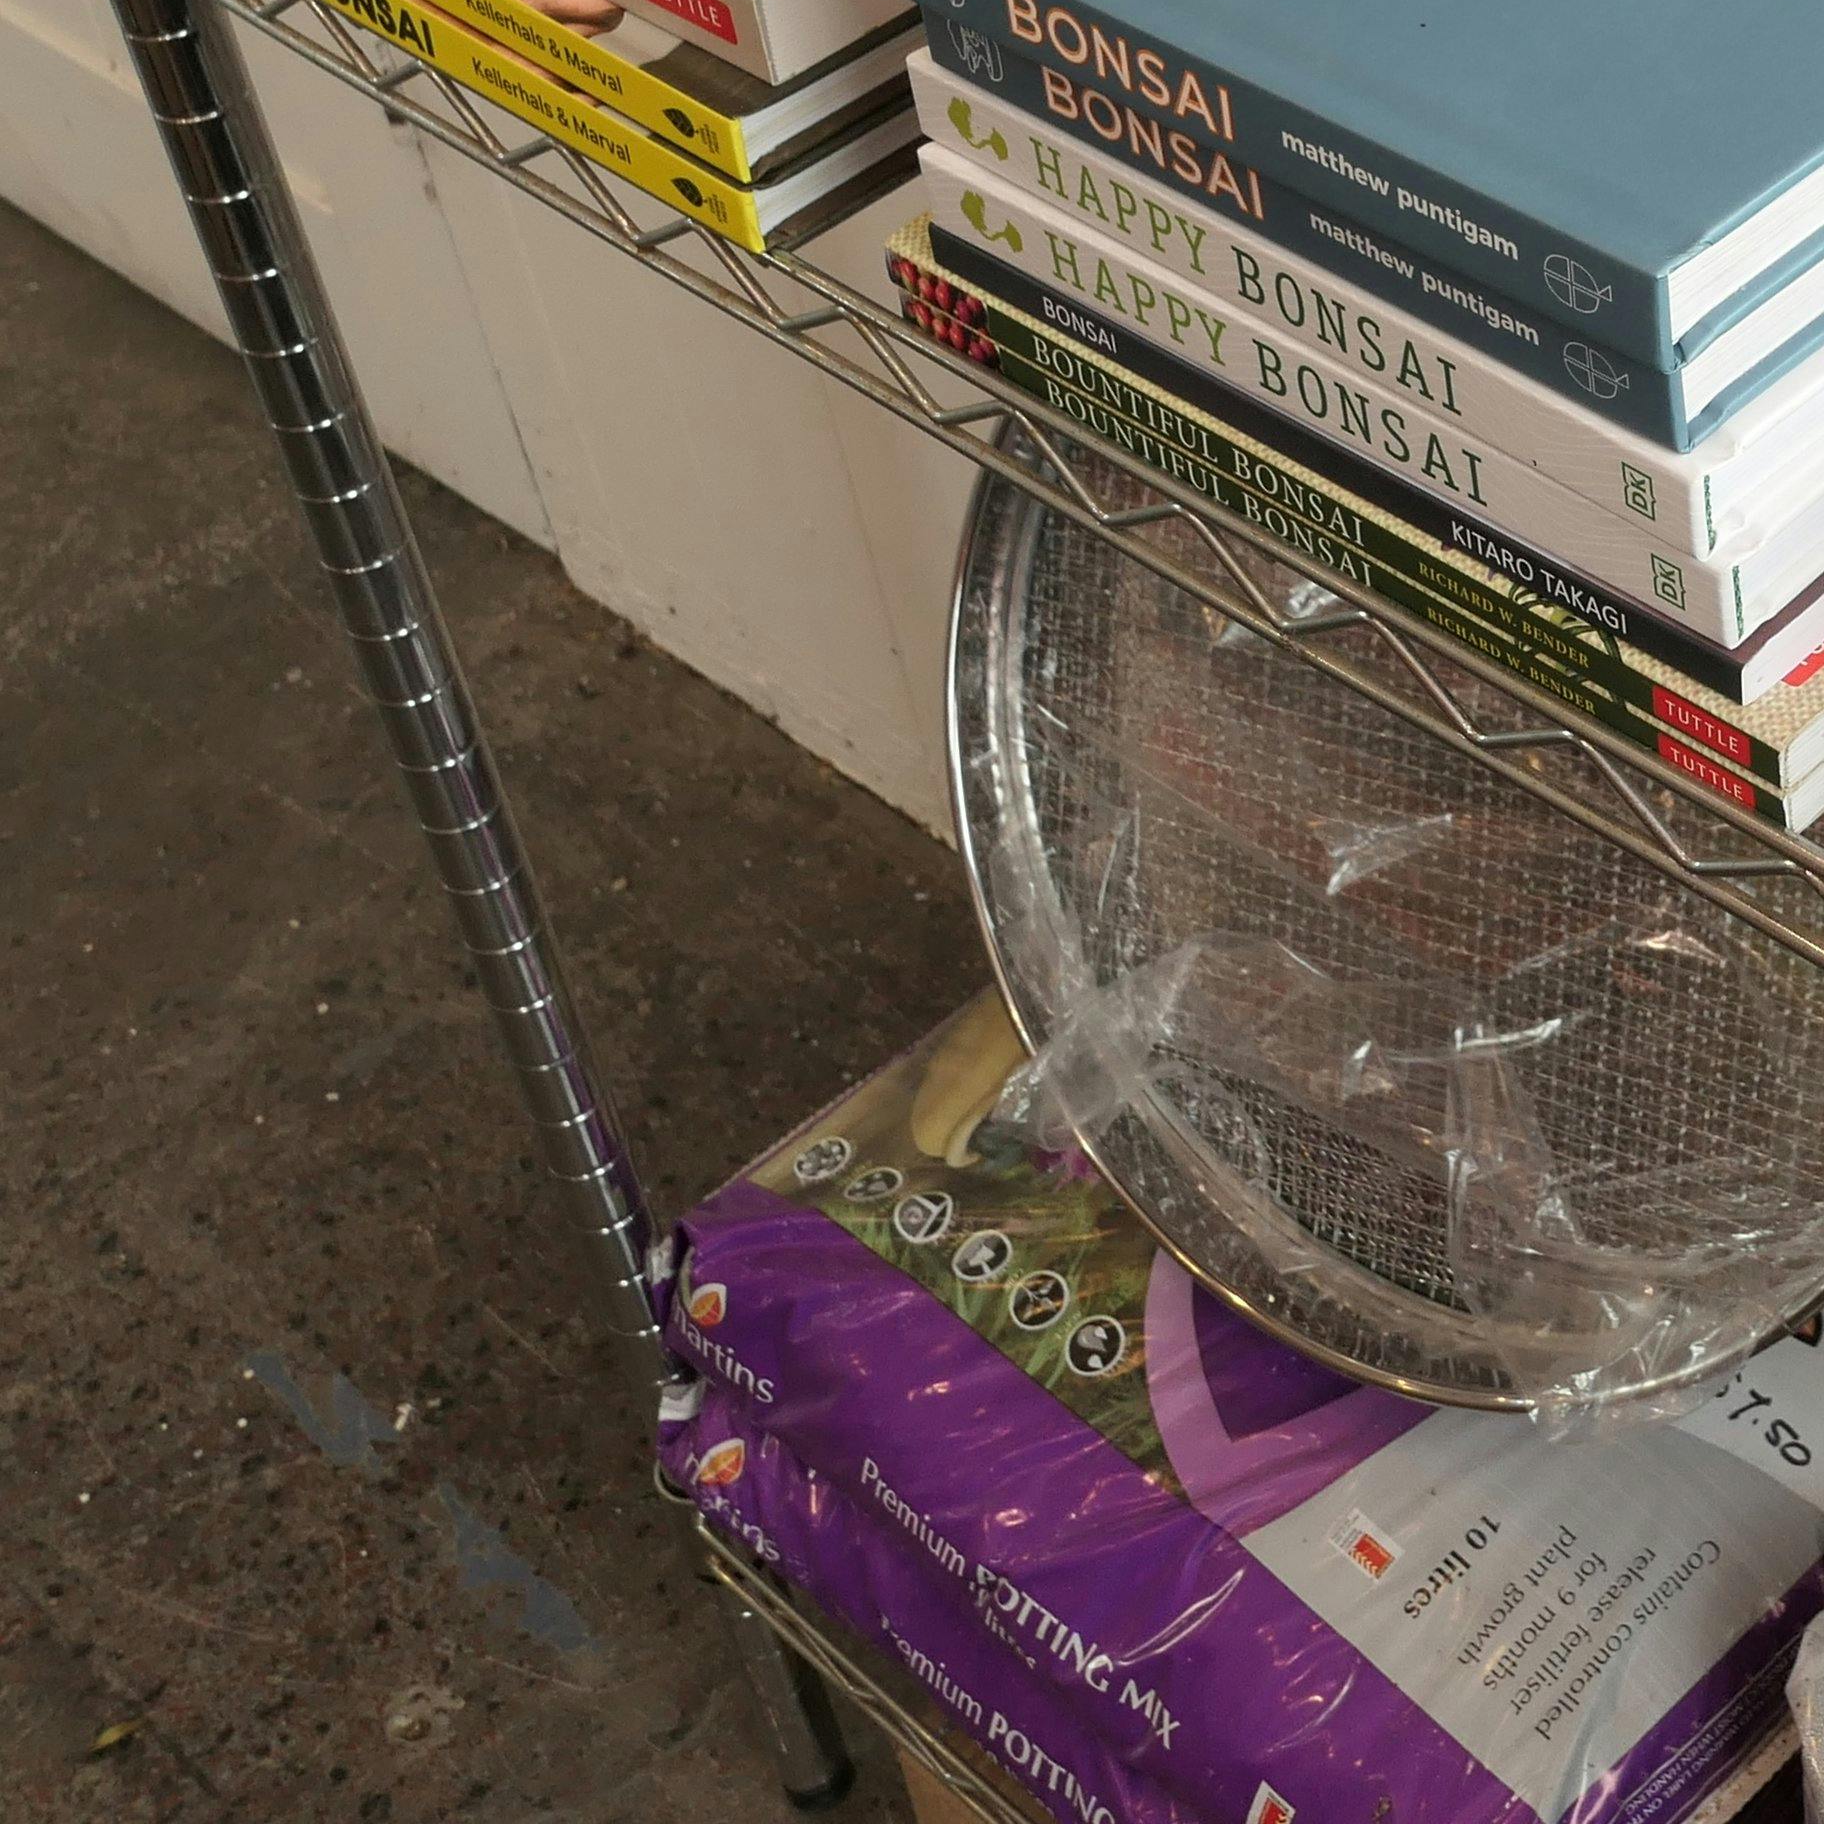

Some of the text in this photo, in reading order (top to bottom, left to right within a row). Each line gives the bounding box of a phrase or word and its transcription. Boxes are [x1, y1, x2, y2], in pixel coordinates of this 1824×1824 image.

[470, 56, 553, 124] Kellerhals
[554, 104, 570, 128] &
[571, 111, 632, 166] Marval
[547, 35, 563, 60] &
[564, 44, 624, 97] Marval
[1041, 64, 1541, 349] BONSAI matthew puntigam
[1281, 128, 1390, 198] matthew
[1396, 184, 1520, 261] puntigam
[1028, 136, 1208, 276] HAPPY
[1230, 245, 1463, 418] BONSAI
[1044, 229, 1228, 367] HAPPY
[1251, 338, 1489, 508] BONSAI
[1031, 334, 1592, 669] BOUNTIFUL BONSAI RICHARD W. BENDER
[1042, 295, 1628, 635] BONSAI KITARO TAKAGI
[1045, 378, 1599, 716] BOUNTIFUL BONSAI RICHARD W. BENDER
[1664, 698, 1740, 754] TUTTLE
[1669, 745, 1745, 802] TUTTLE
[860, 1456, 967, 1578] Premium
[1119, 1677, 1182, 1751] MIX
[1403, 1514, 1501, 1621] 10 litres
[1456, 1523, 1579, 1669] plant growth
[1481, 1550, 1610, 1693] for 9 months
[1512, 1546, 1658, 1718] release fertiliser
[1632, 1538, 1722, 1628] Contains
[1533, 1621, 1634, 1743] controlled
